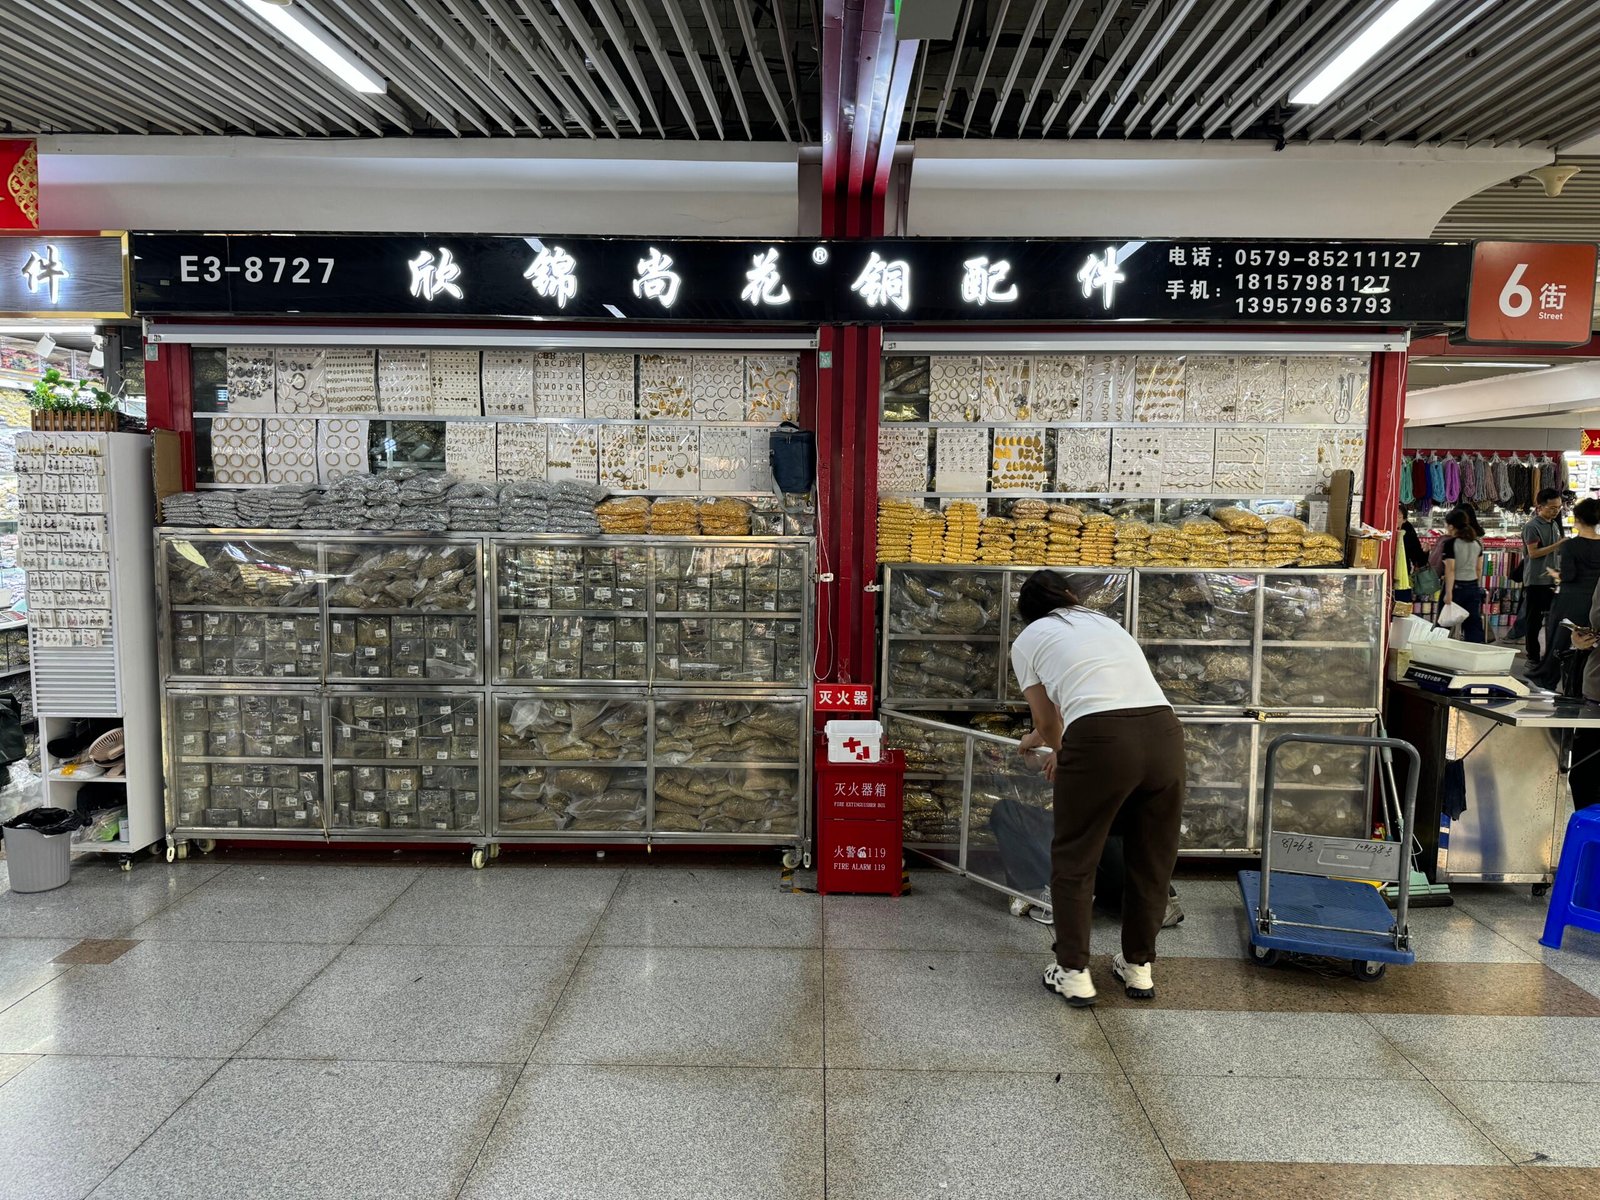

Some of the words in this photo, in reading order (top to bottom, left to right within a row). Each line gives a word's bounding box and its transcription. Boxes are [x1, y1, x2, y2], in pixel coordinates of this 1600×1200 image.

[1235, 249, 1421, 268] 0579-85211127
[20, 243, 72, 304] 件
[180, 255, 335, 284] E3-8727
[1235, 273, 1390, 293] 18157981127
[1235, 296, 1392, 314] 13957963793
[1538, 311, 1564, 320] Street
[818, 690, 868, 706] 灭火器
[834, 782, 887, 797] 灭火器箱
[834, 845, 857, 858] 火警
[867, 847, 886, 858] 119
[833, 862, 850, 870] FIRE
[874, 863, 886, 871] 119
